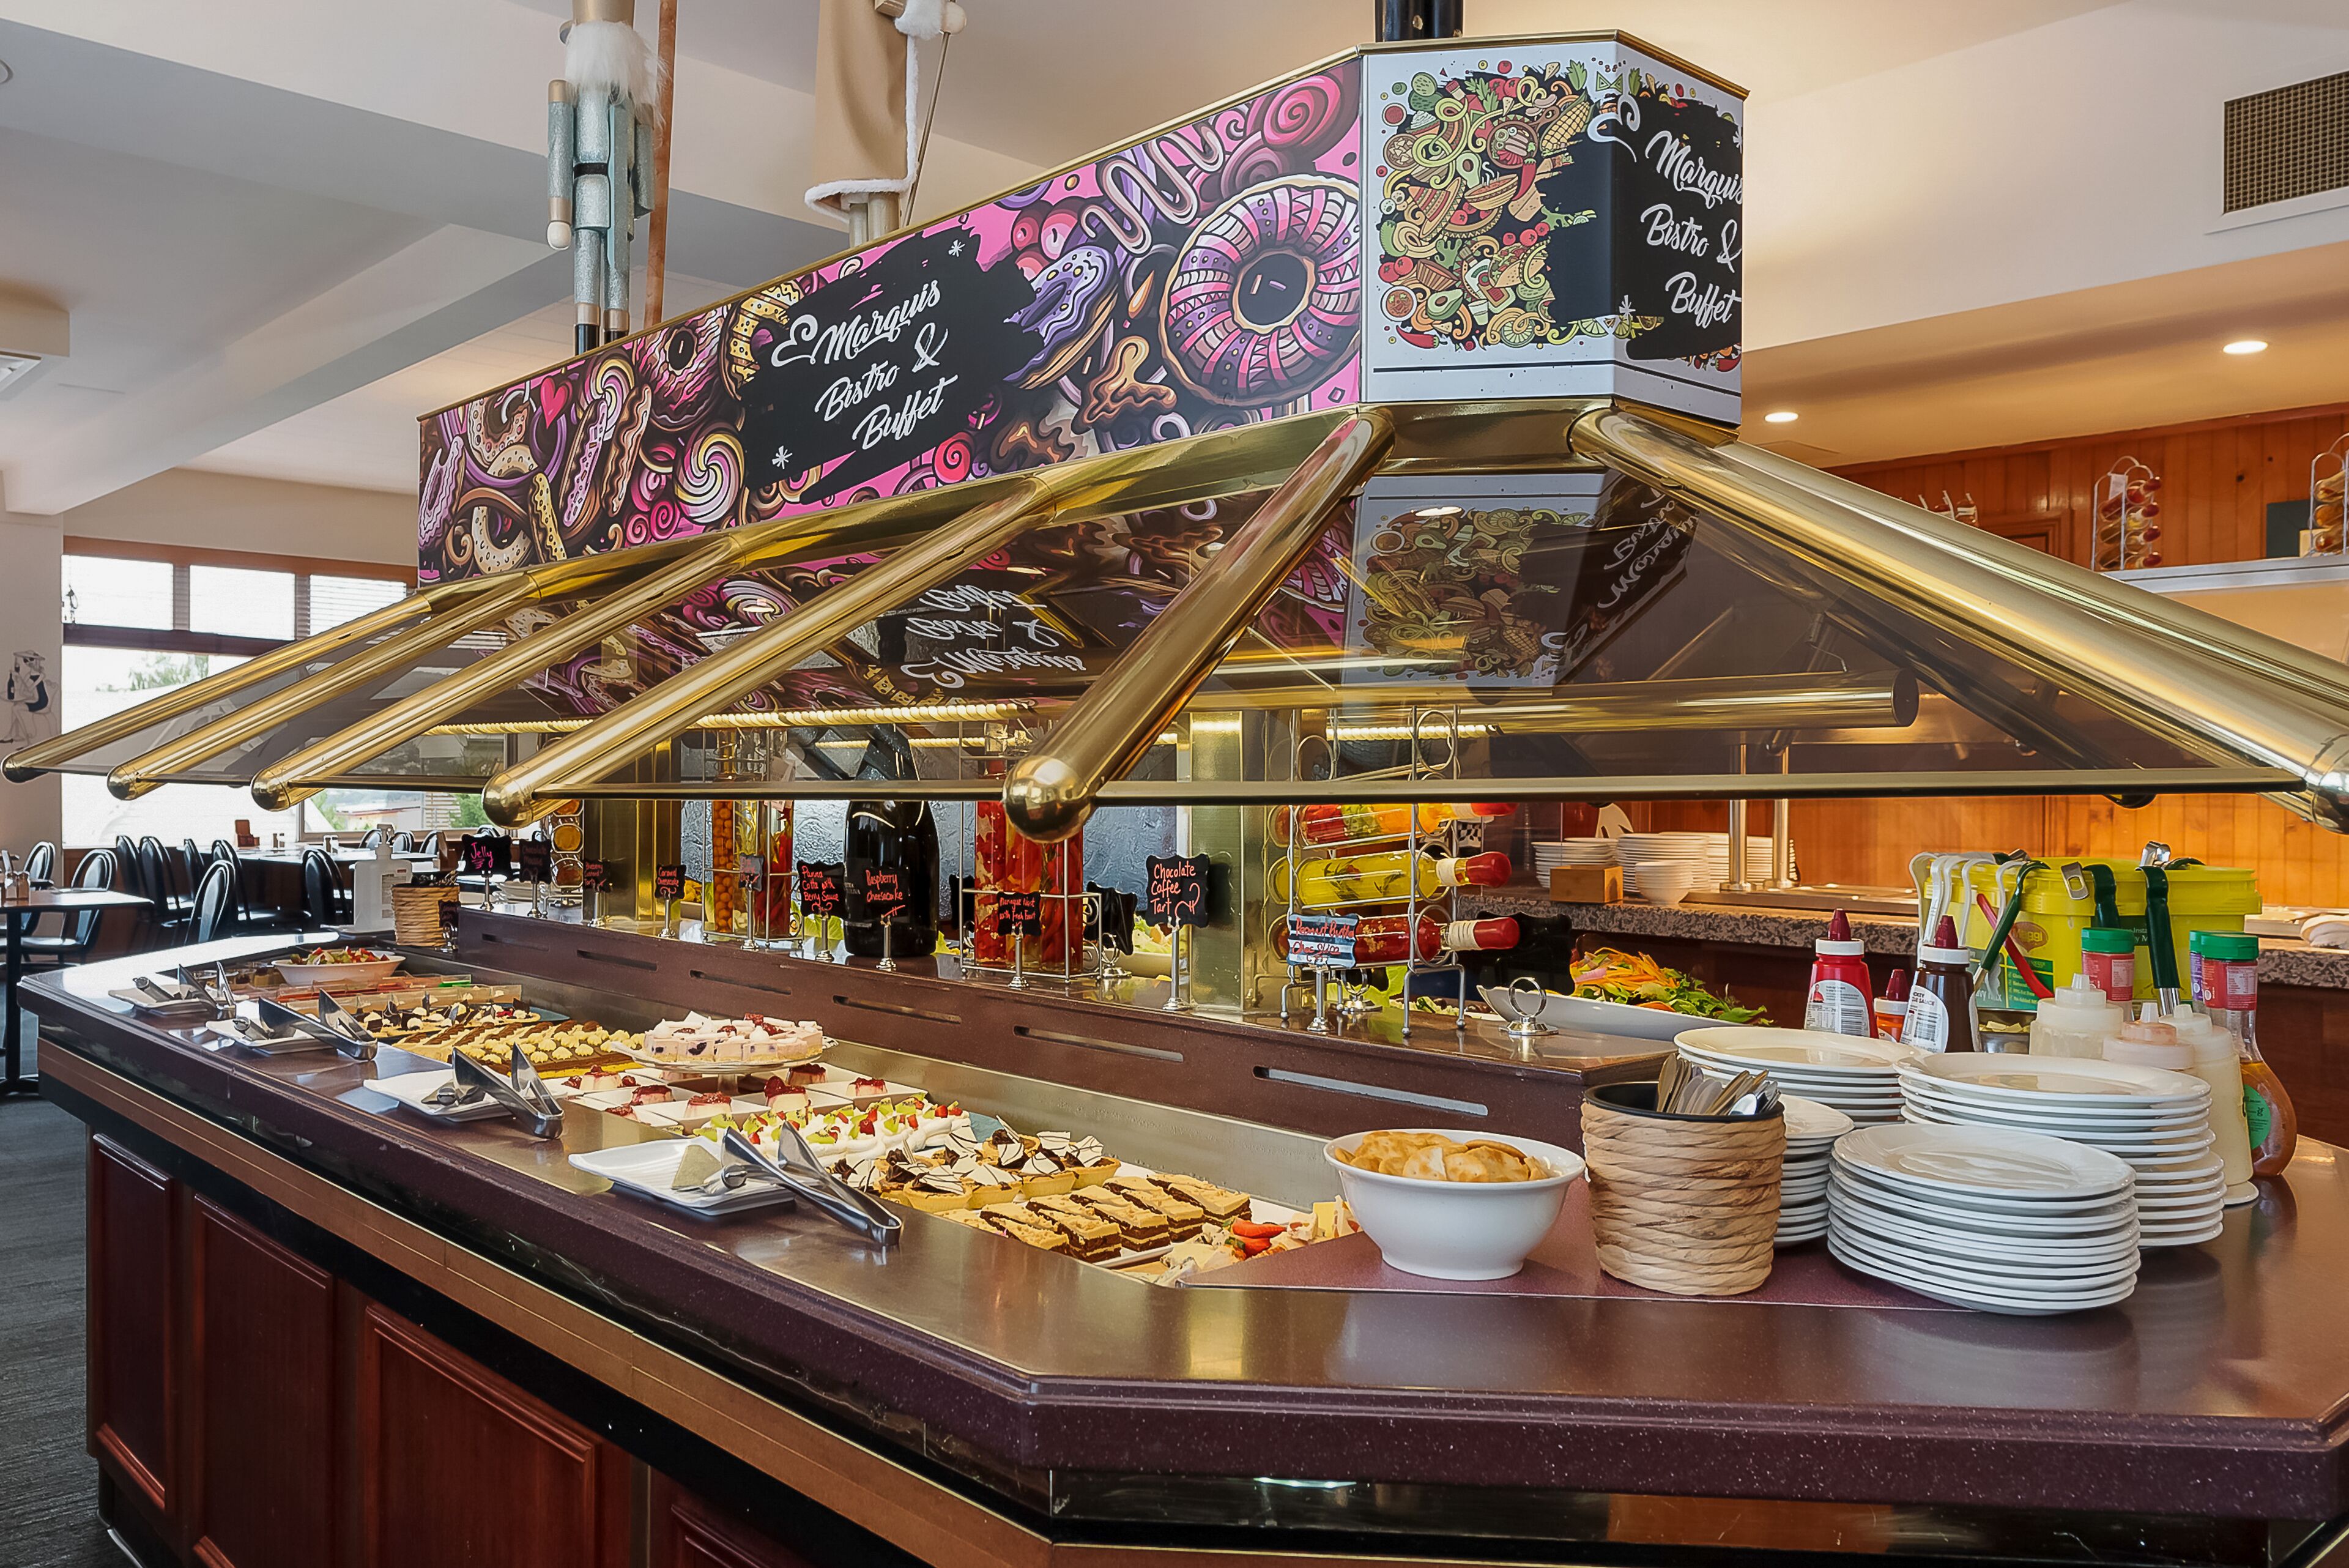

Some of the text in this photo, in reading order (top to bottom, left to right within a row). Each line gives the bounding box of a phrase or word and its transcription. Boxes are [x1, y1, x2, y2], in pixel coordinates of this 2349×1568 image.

[1644, 130, 1743, 209] Marquis
[1640, 204, 1742, 273] Bistro &
[1665, 272, 1742, 329] Buffet
[814, 322, 949, 422] Bistro &
[852, 374, 959, 450] Buffet
[470, 842, 494, 868] Jelly
[801, 866, 823, 878] Panna
[866, 869, 898, 890] Raspberry
[1154, 860, 1197, 879] Chocolate
[802, 881, 818, 890] Cotta
[822, 877, 836, 890] with
[1151, 879, 1181, 899] Coffee
[803, 891, 840, 905] Berry Sauce
[1150, 897, 1172, 915] Tart
[1296, 917, 1329, 937] Peanut
